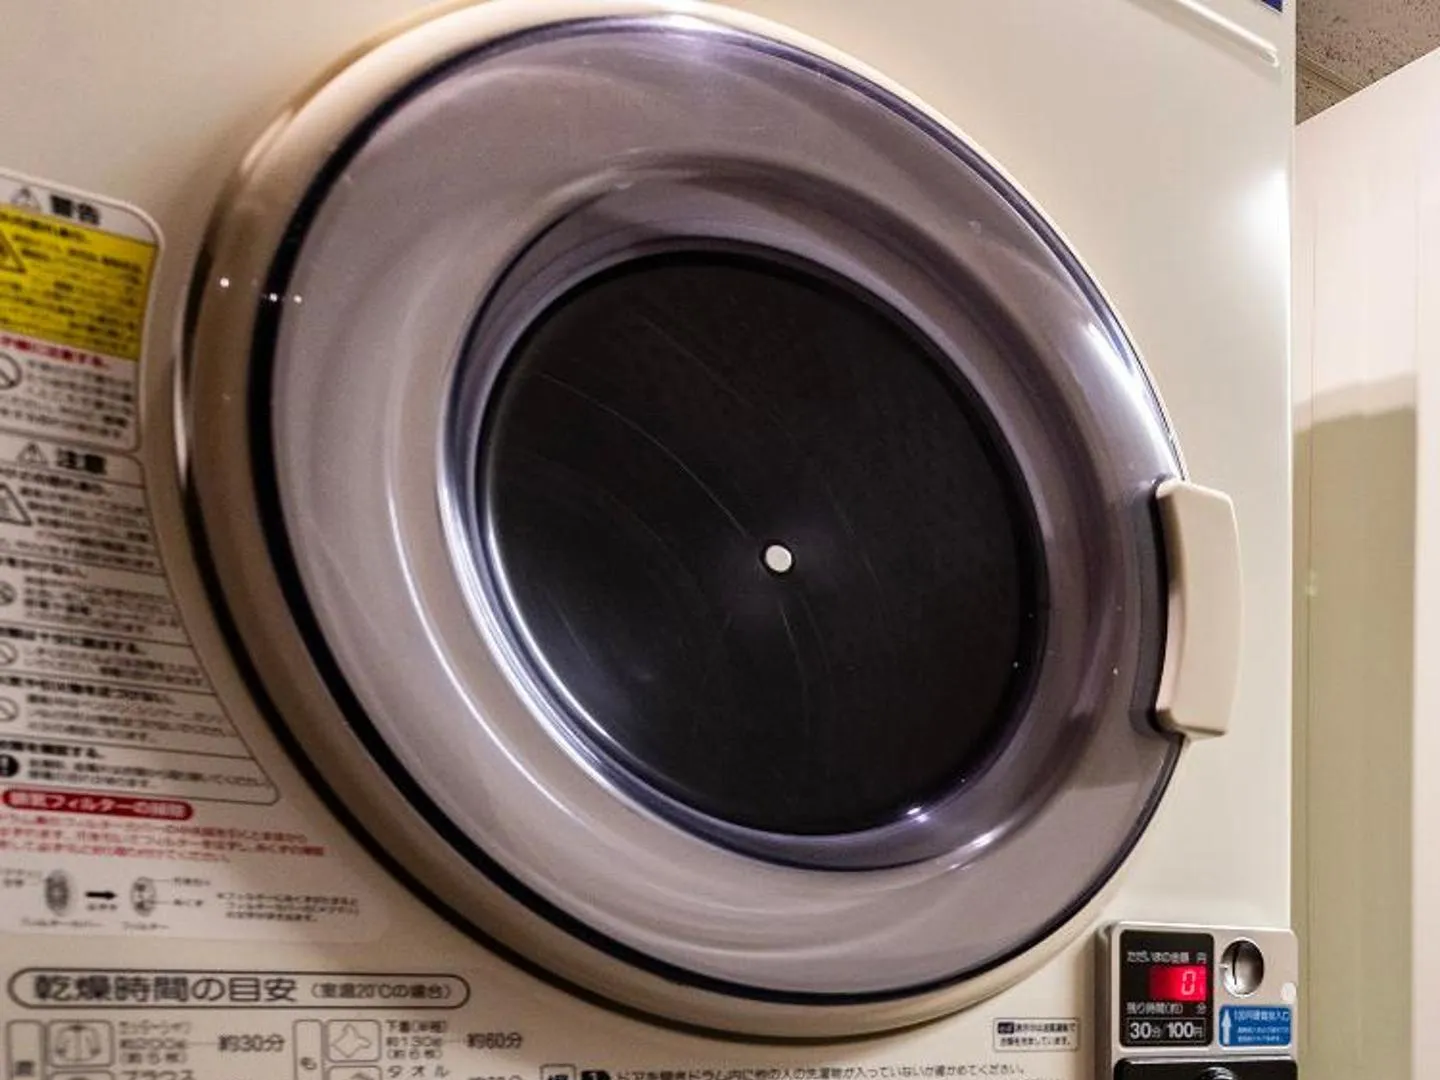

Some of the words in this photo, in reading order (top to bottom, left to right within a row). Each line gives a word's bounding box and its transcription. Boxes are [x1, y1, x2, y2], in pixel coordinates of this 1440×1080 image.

[35, 974, 297, 1002] 乾燥時間の目安
[1181, 970, 1196, 996] 0
